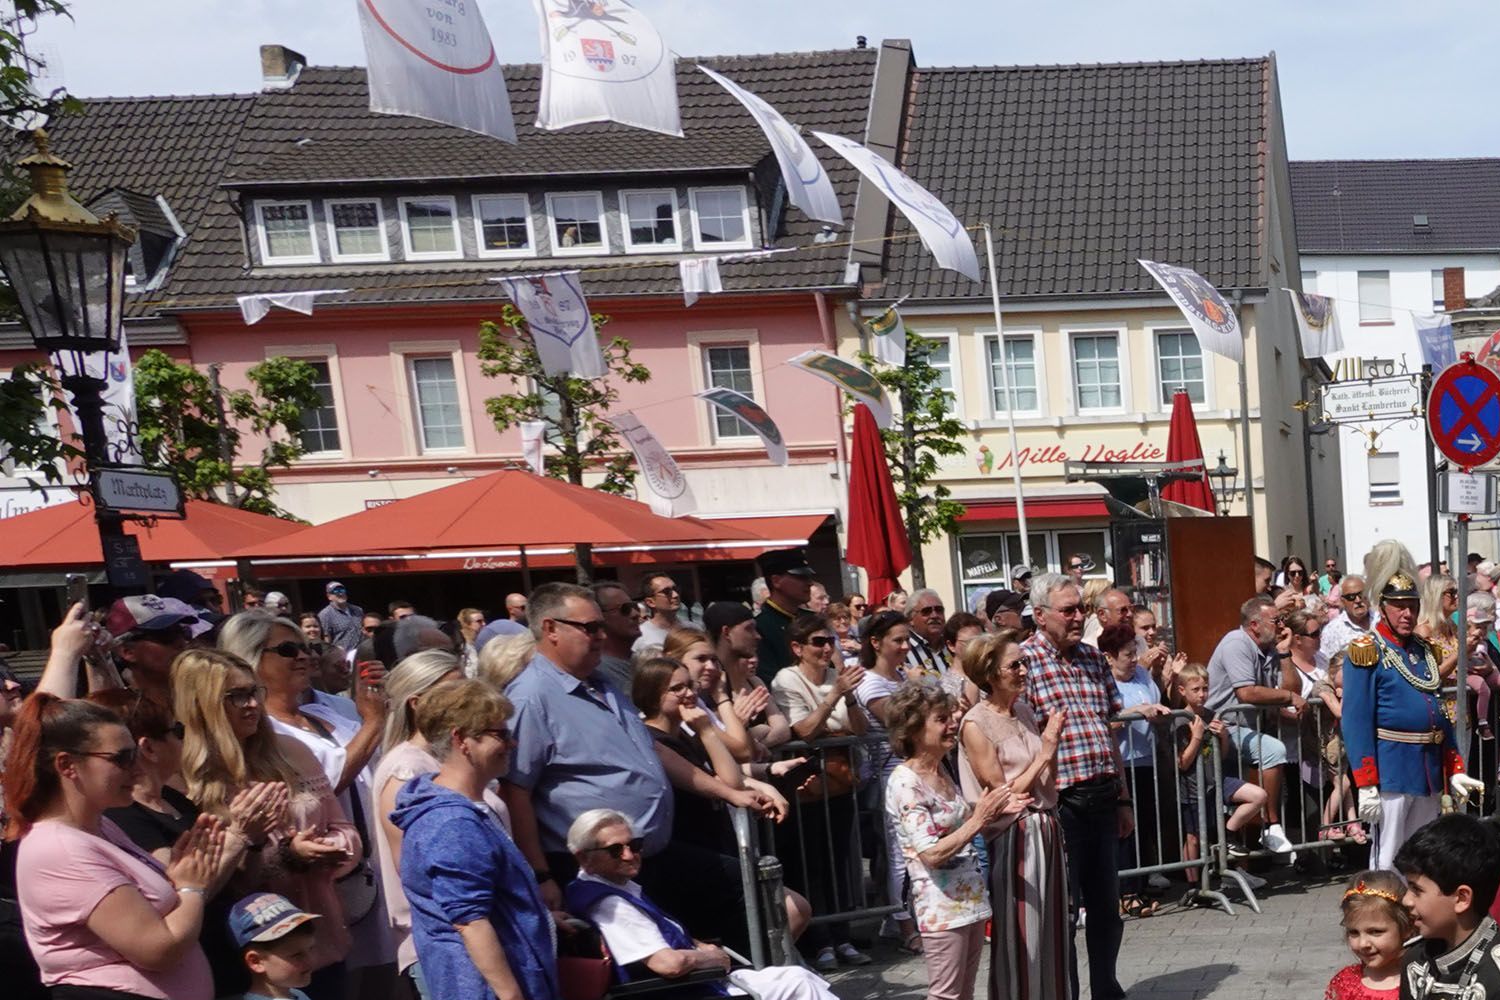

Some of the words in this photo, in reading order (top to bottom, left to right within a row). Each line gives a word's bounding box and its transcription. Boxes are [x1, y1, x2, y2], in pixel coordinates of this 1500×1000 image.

[426, 7, 453, 25] von
[431, 27, 457, 47] 1983
[1331, 392, 1350, 400] Kath.
[1335, 403, 1360, 413] Sankt
[1361, 400, 1408, 412] Lambertus
[997, 444, 1070, 471] Mille
